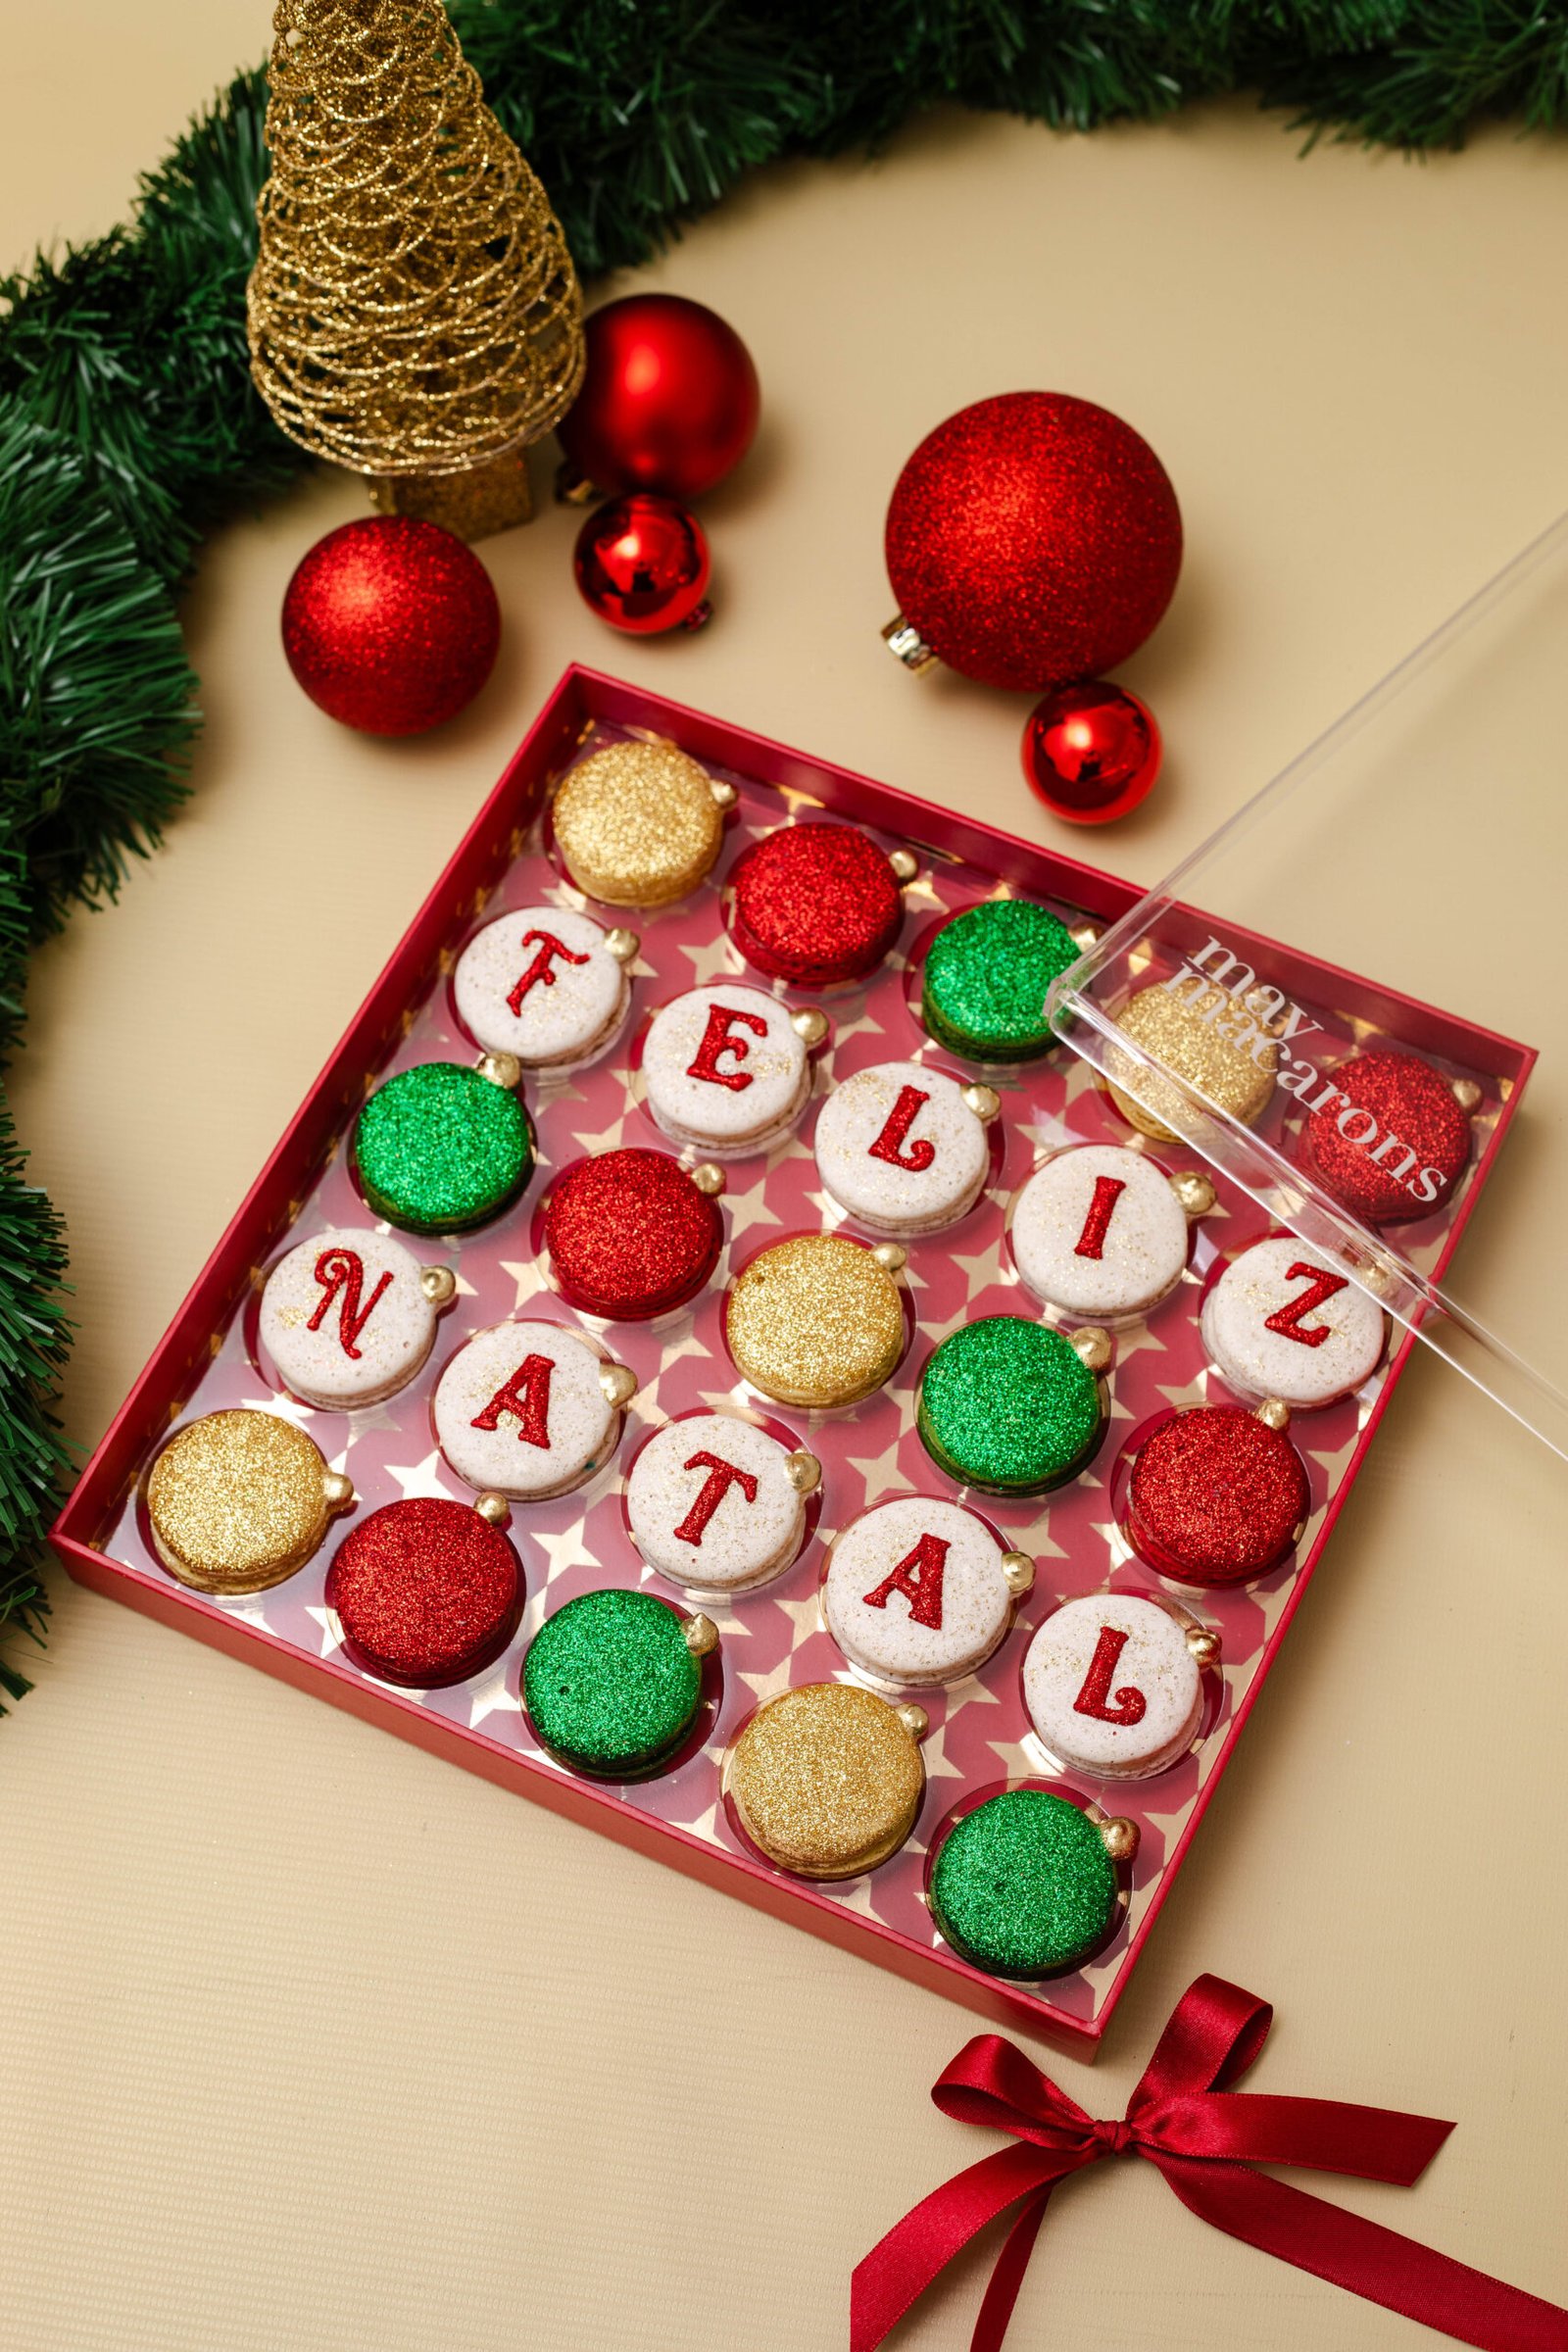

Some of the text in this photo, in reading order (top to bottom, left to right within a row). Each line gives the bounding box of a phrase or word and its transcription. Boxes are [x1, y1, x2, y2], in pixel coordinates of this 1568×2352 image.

[506, 927, 1349, 1348] FELIZ
[1158, 960, 1448, 1202] macarons
[1186, 934, 1324, 1044] may
[306, 1247, 1148, 1727] NATAL
